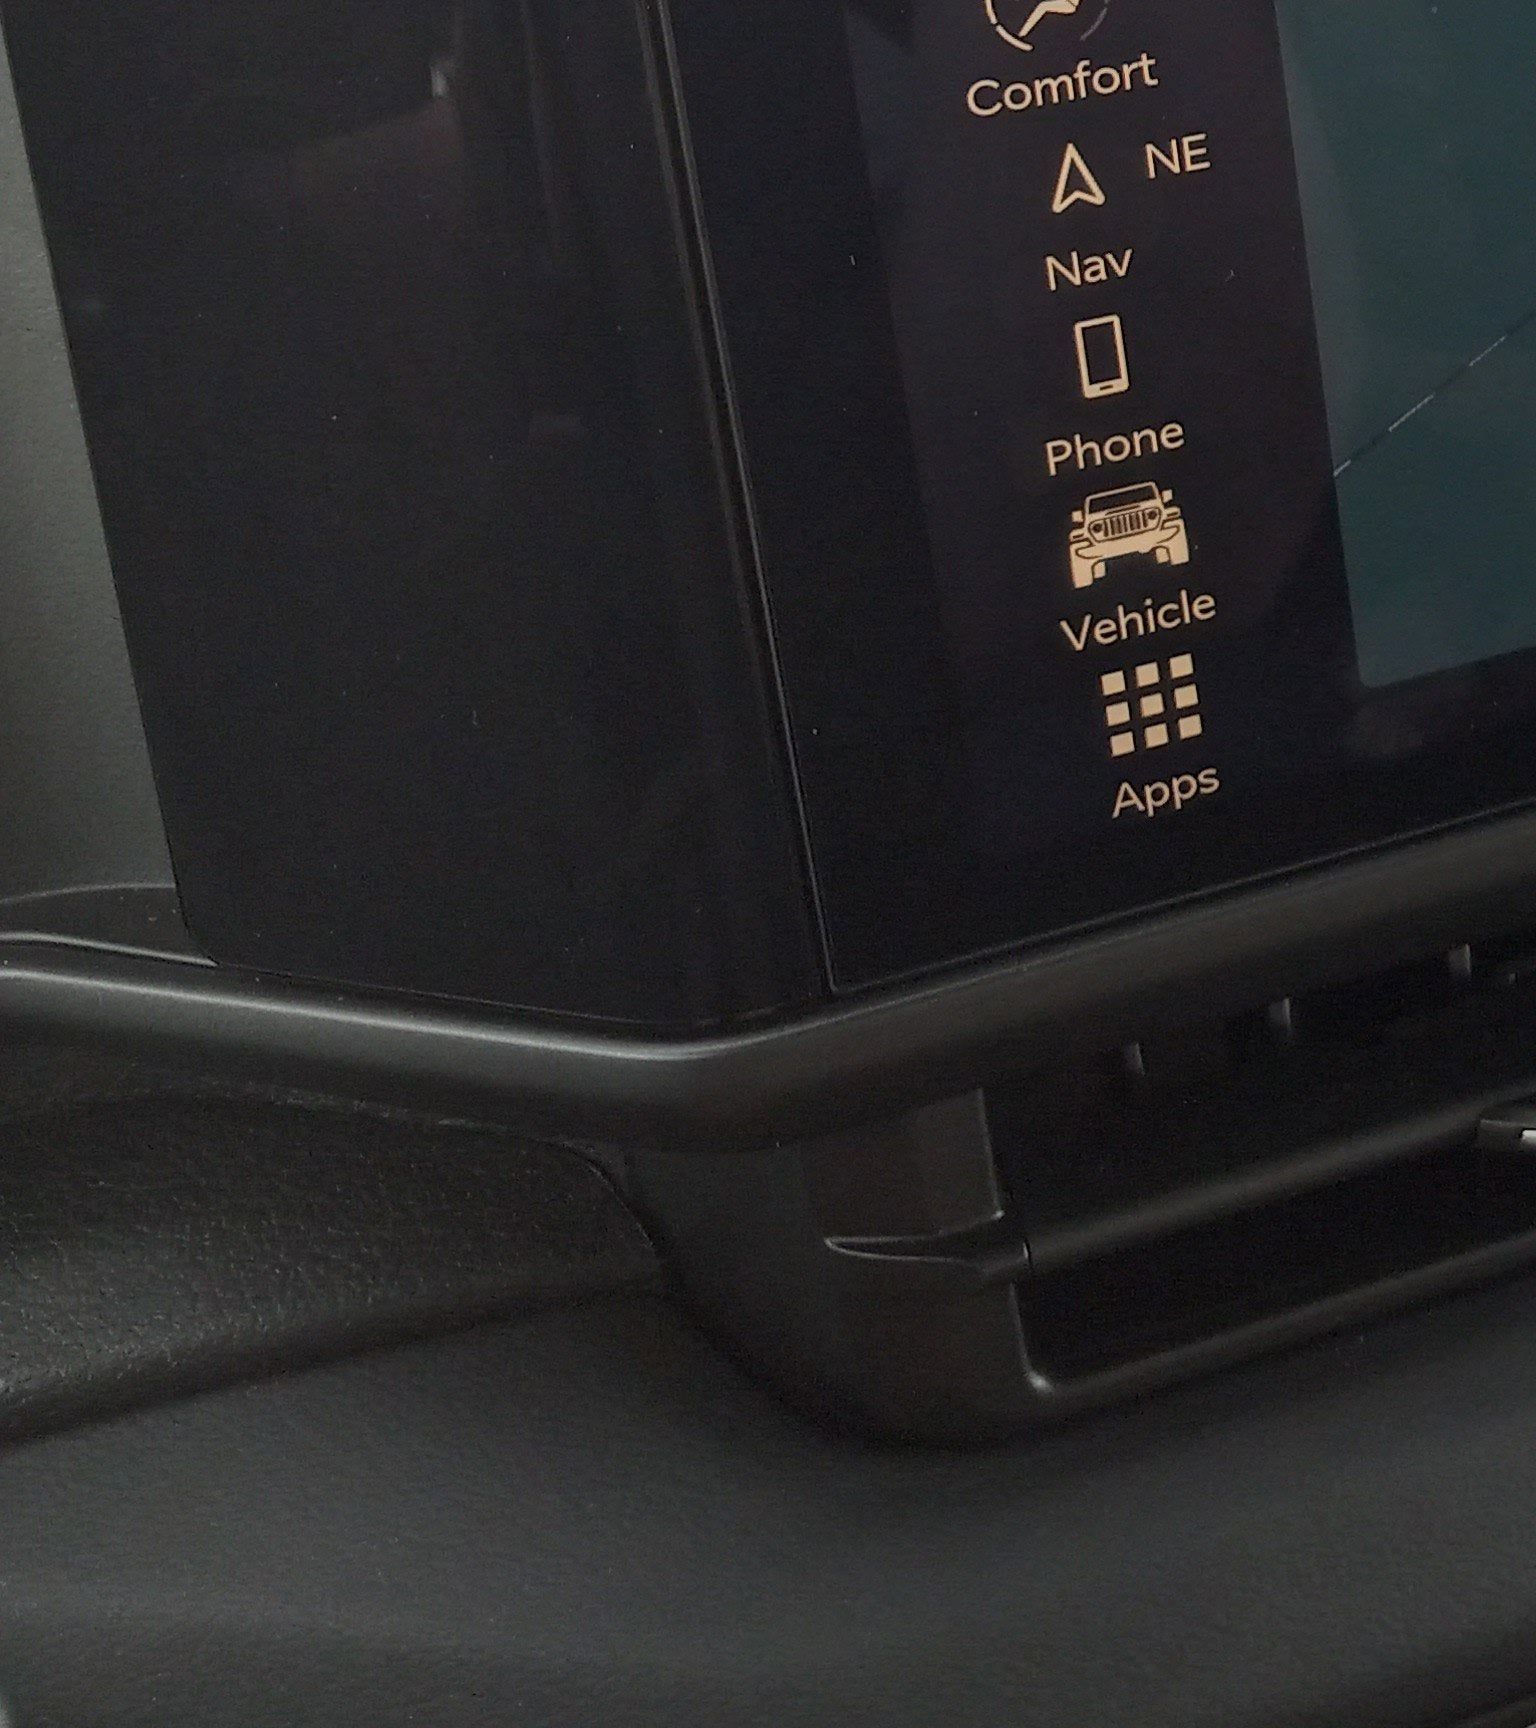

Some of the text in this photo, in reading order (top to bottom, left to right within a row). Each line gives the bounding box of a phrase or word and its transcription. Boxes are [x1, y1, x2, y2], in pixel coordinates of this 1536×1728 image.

[966, 53, 1160, 117] Comfort
[1145, 133, 1211, 179] NE
[1044, 248, 1134, 292] Nav
[1044, 421, 1186, 476] Phone
[1059, 589, 1217, 653] Vehicle
[1111, 767, 1221, 819] Apps
